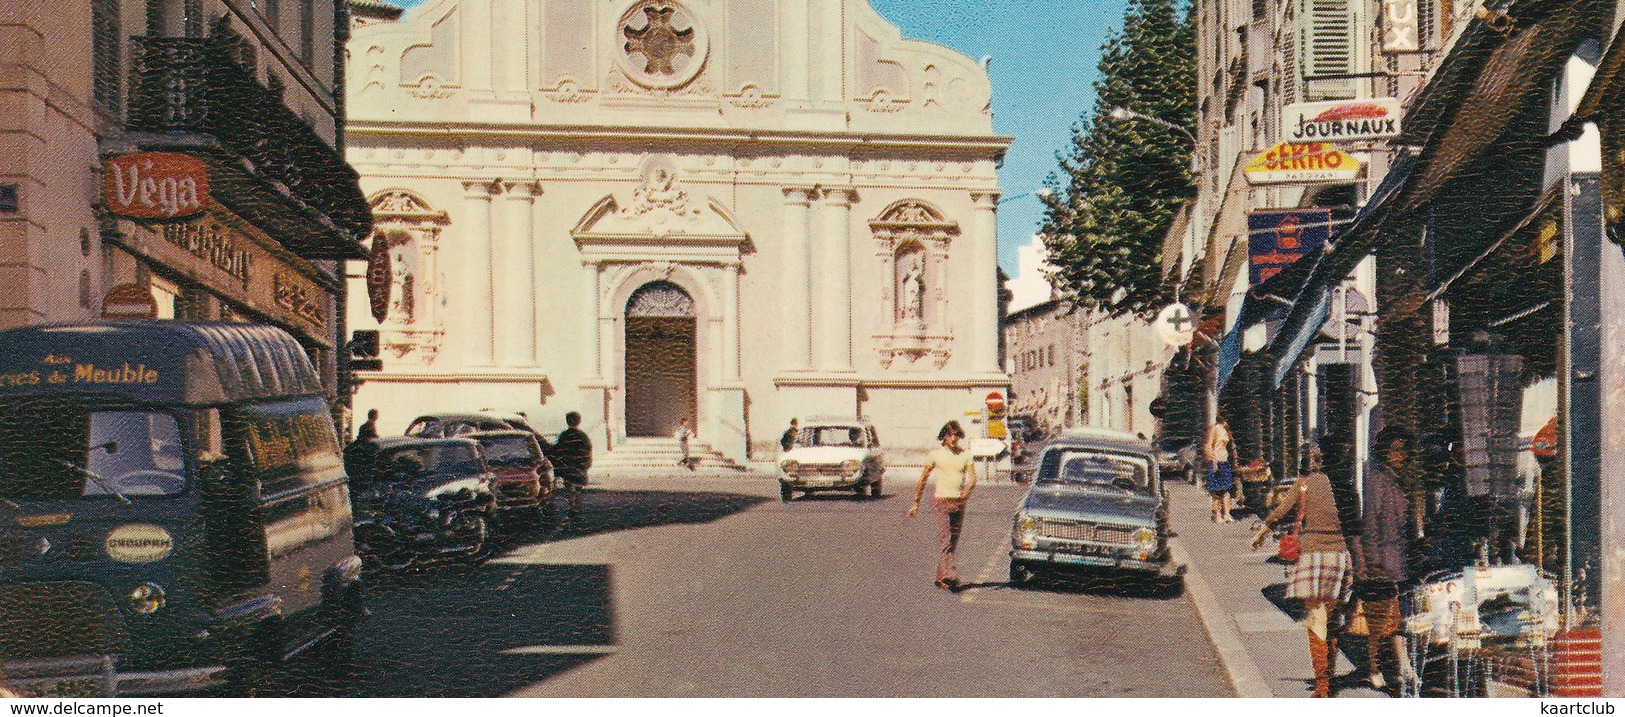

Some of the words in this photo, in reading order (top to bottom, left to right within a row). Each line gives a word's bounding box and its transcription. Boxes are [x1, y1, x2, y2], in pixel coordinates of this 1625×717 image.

[1292, 112, 1395, 138] JOURNAUX
[111, 161, 199, 216] Véga
[74, 362, 159, 383] Meuble
